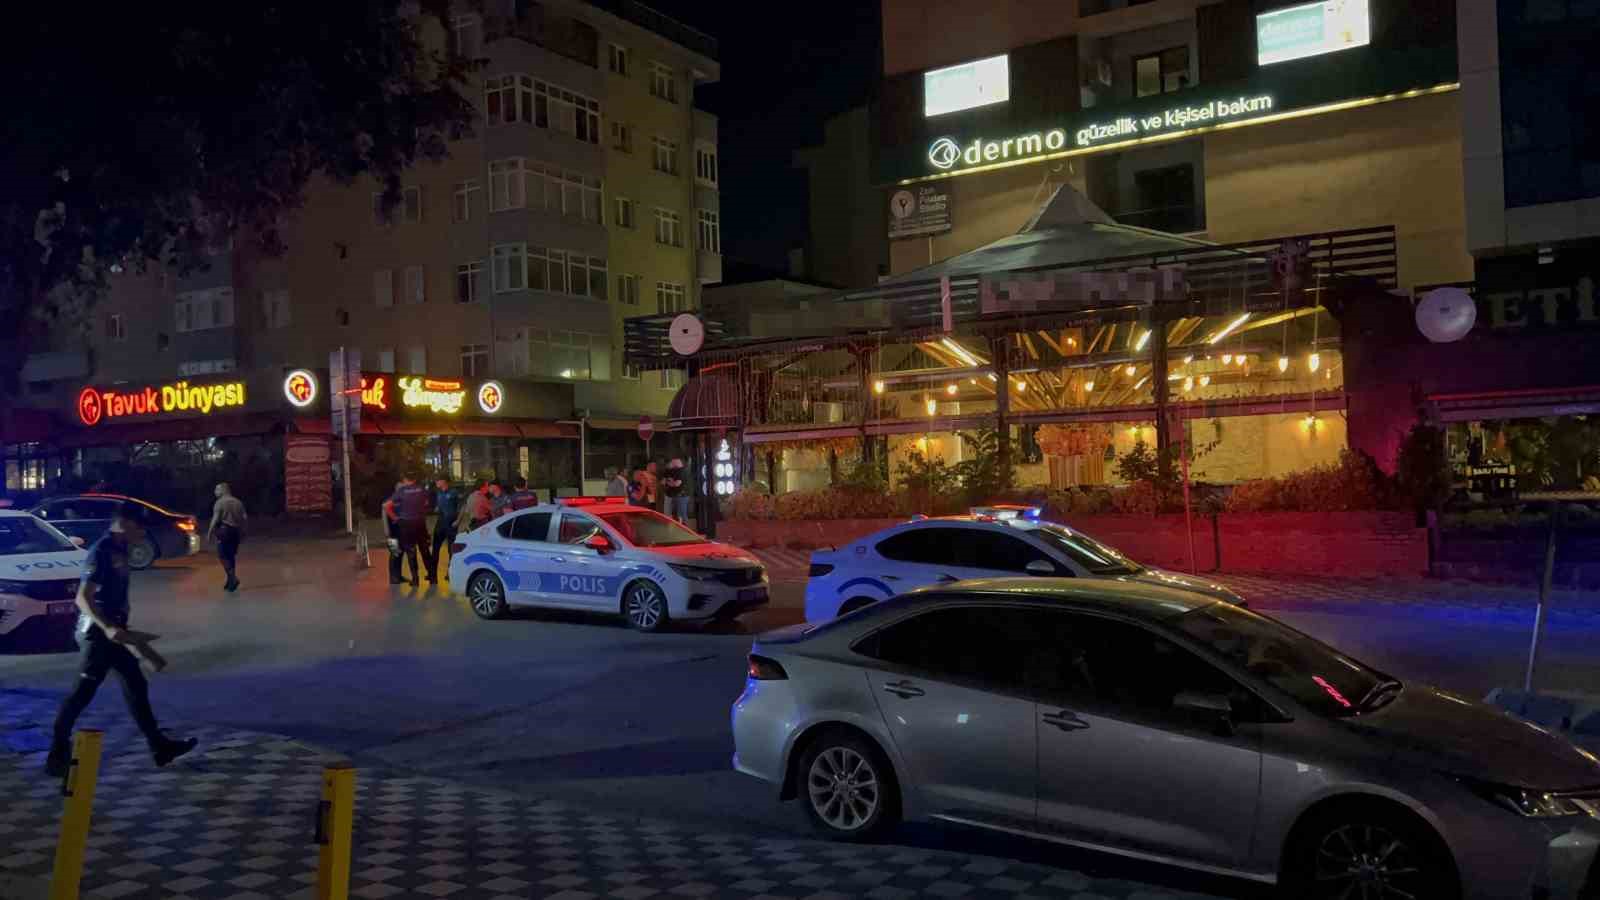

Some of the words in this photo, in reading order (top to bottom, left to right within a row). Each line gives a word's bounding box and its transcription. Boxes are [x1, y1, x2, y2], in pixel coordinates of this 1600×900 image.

[963, 130, 1065, 164] dermo
[1076, 116, 1138, 146] güzellik
[1141, 115, 1162, 131] ve
[1164, 106, 1214, 127] kişisel
[1217, 93, 1273, 117] bakım
[102, 387, 160, 417] Tavuk
[162, 381, 244, 414] Dünyası
[16, 559, 80, 572] POLI
[560, 575, 607, 593] POLIS
